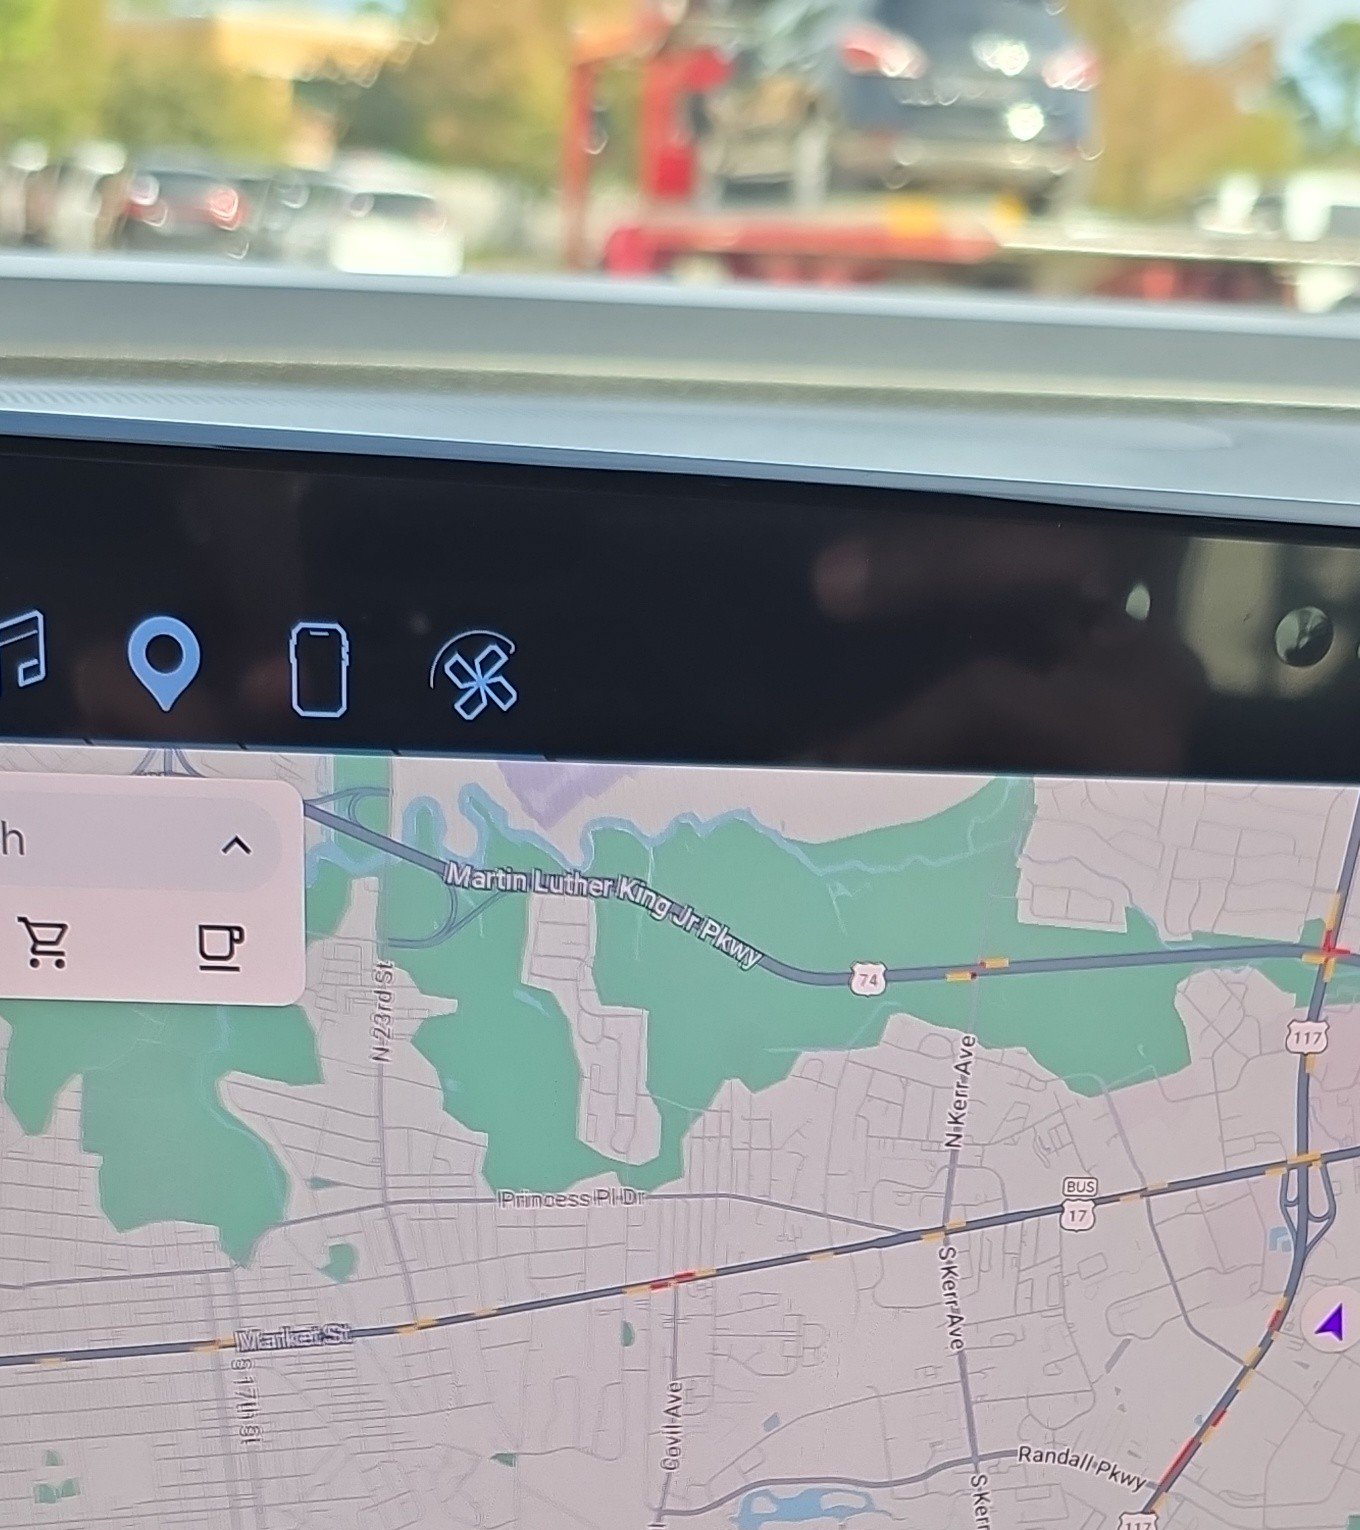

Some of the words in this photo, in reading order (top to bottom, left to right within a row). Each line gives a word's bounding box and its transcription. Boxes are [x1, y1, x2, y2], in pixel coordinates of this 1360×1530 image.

[446, 862, 527, 891] Martin
[533, 868, 612, 899] Luther
[618, 875, 672, 920] King
[672, 906, 701, 933] Jr
[699, 917, 763, 970] Pkwy
[376, 960, 394, 985] St
[859, 973, 878, 987] 74
[374, 989, 393, 1038] 23rd
[1295, 1032, 1322, 1045] 117
[372, 1047, 392, 1063] N
[954, 1035, 976, 1075] Ave
[947, 1080, 970, 1127] Kerr
[945, 1132, 962, 1149] N
[498, 1190, 590, 1208] Princess
[593, 1188, 616, 1206] Pl
[621, 1189, 645, 1205] Dr
[1066, 1181, 1095, 1193] BUS
[1069, 1209, 1087, 1222] 17
[938, 1246, 956, 1260] S
[940, 1265, 963, 1311] Kerr
[946, 1313, 965, 1350] Ave
[663, 1382, 683, 1418] Ave
[971, 1474, 988, 1487] S
[1018, 1445, 1093, 1472] Randall
[1095, 1460, 1147, 1493] Pkwy
[973, 1493, 990, 1530] Kerr
